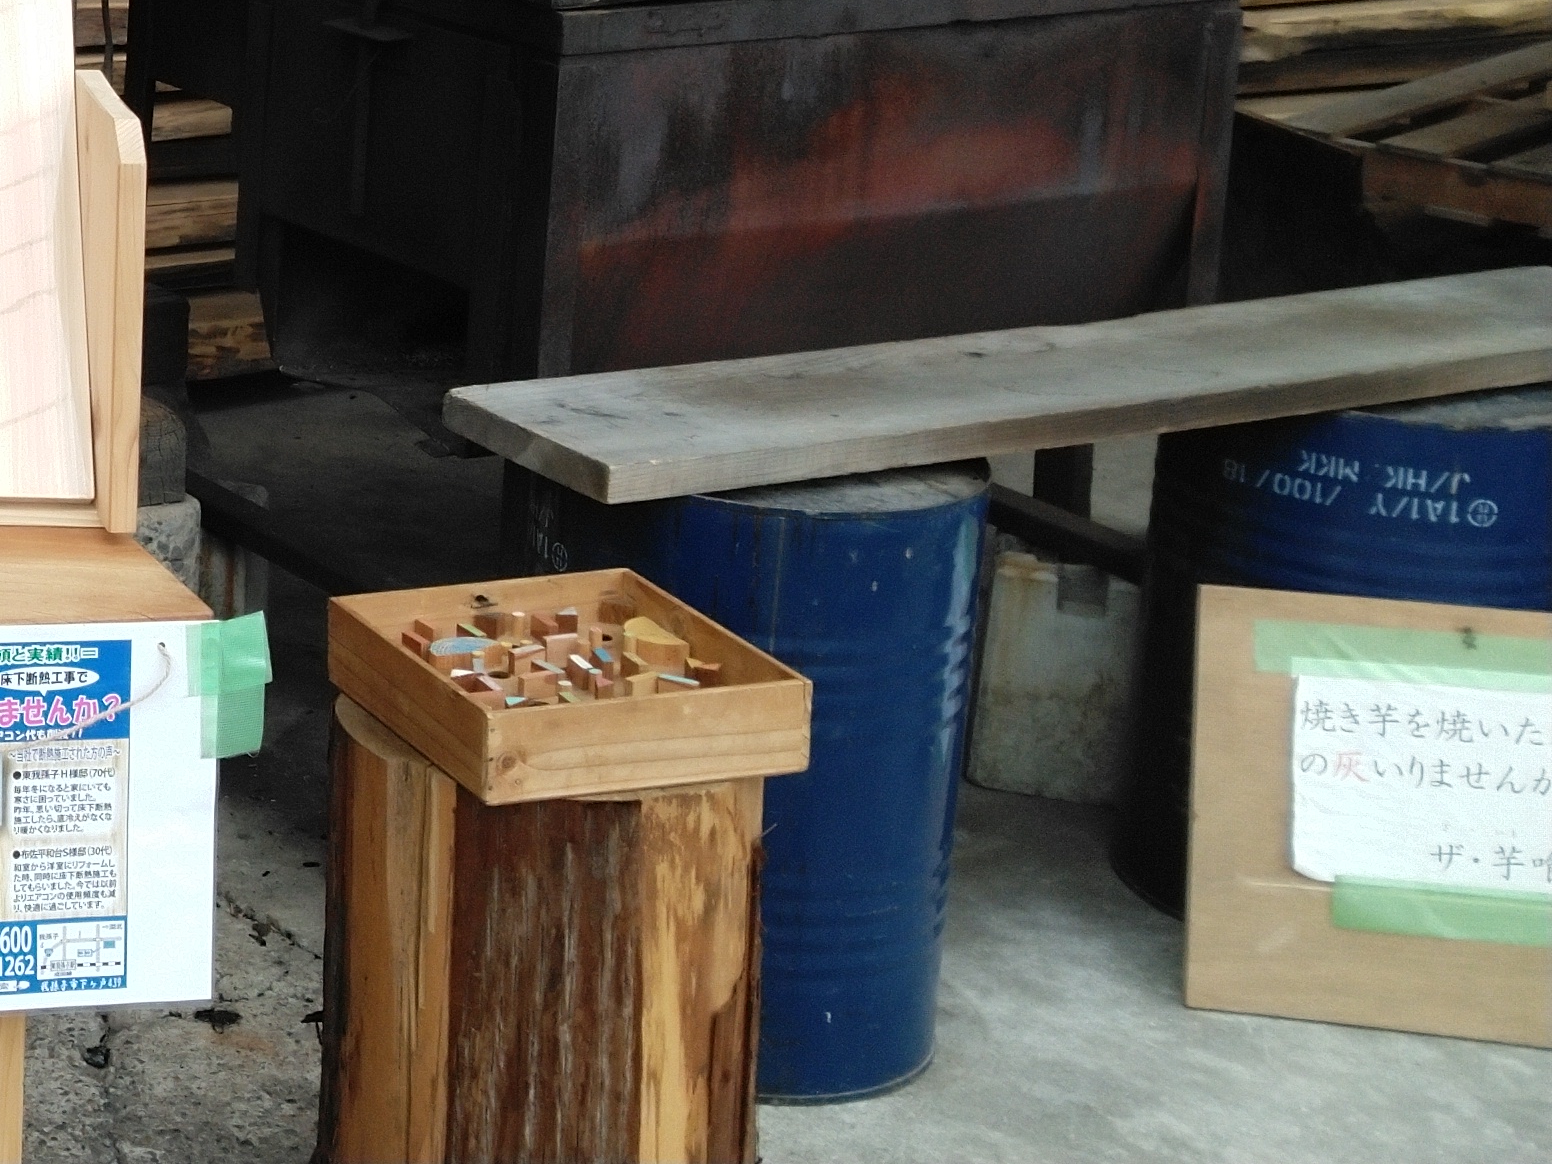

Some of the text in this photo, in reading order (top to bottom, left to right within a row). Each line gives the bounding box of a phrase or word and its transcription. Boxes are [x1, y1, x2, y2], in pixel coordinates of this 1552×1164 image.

[1297, 448, 1360, 484] MKK
[0, 670, 89, 686] 床下断熱工事で
[1300, 699, 1546, 747] 焼き芋を焼いた
